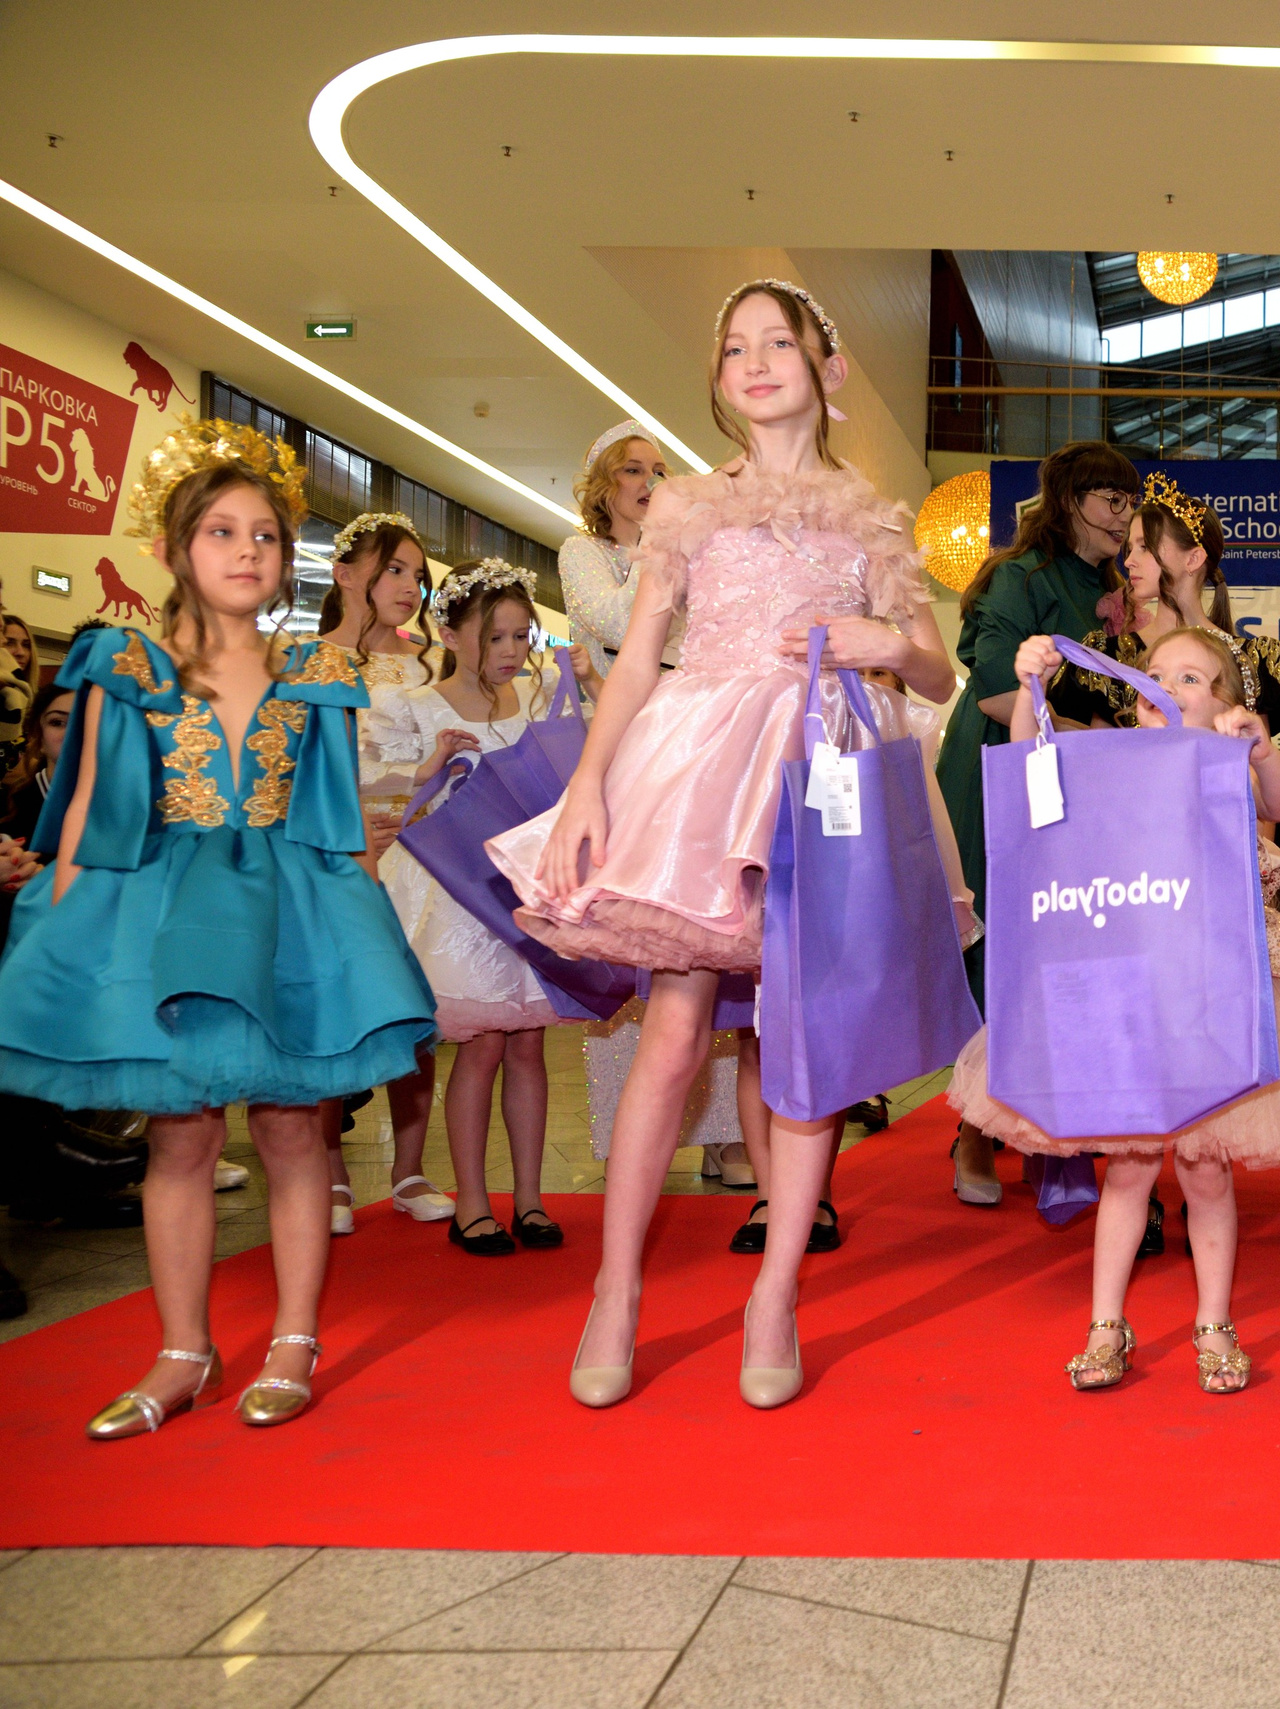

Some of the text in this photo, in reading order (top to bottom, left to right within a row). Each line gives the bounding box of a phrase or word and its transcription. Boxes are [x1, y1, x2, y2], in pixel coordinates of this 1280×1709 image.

[0, 367, 99, 427] ПАРКОВКА
[0, 396, 66, 485] P5
[0, 474, 39, 496] УРОВЕНЬ
[67, 497, 98, 514] СЕКТОР
[1032, 871, 1190, 926] playToday
